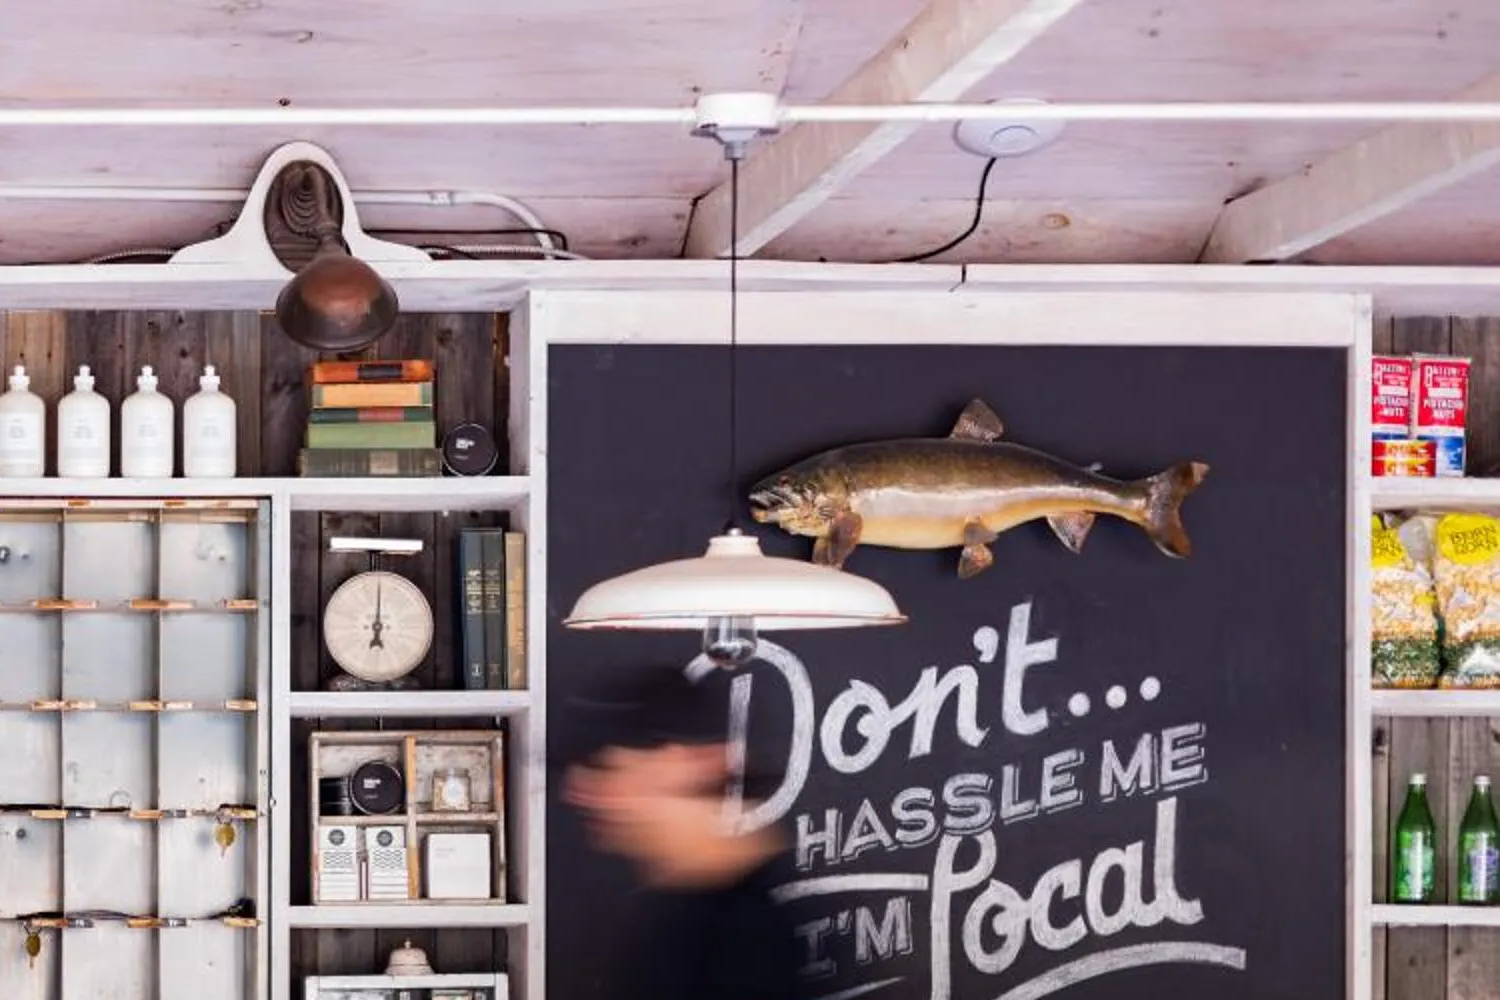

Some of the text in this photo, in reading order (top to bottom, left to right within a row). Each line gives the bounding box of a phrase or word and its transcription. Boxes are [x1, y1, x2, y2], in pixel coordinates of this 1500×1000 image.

[794, 722, 1209, 870] HASSLE ME
[795, 895, 916, 978] I'M
